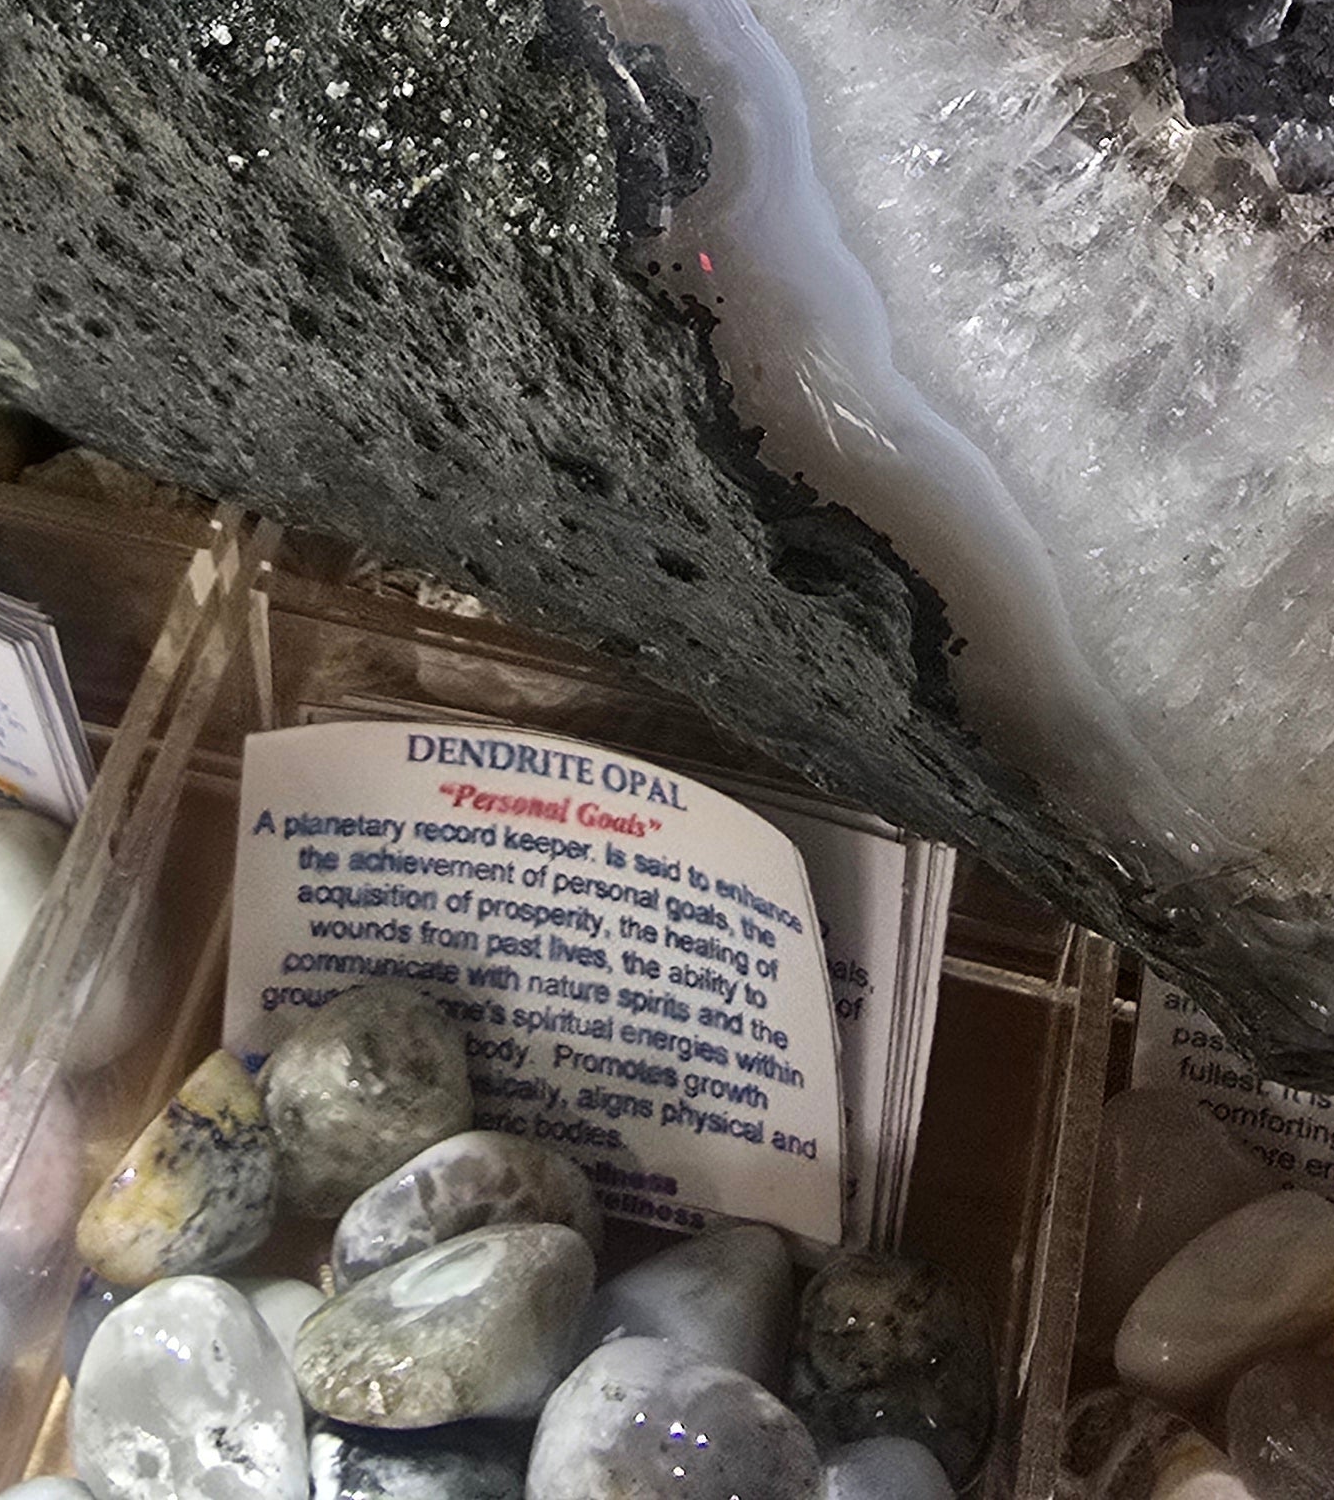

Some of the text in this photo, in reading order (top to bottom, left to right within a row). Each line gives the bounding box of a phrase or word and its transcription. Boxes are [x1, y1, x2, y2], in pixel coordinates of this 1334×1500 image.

[407, 734, 688, 812] DENDRITE OPAL
[439, 783, 662, 838] “Personal Goals”
[253, 809, 803, 935] A planetary record keeper. Is said to enhance
[298, 844, 776, 949] the achievement of personal goals, the
[297, 883, 778, 982] acquisition of prosperity, the healing of
